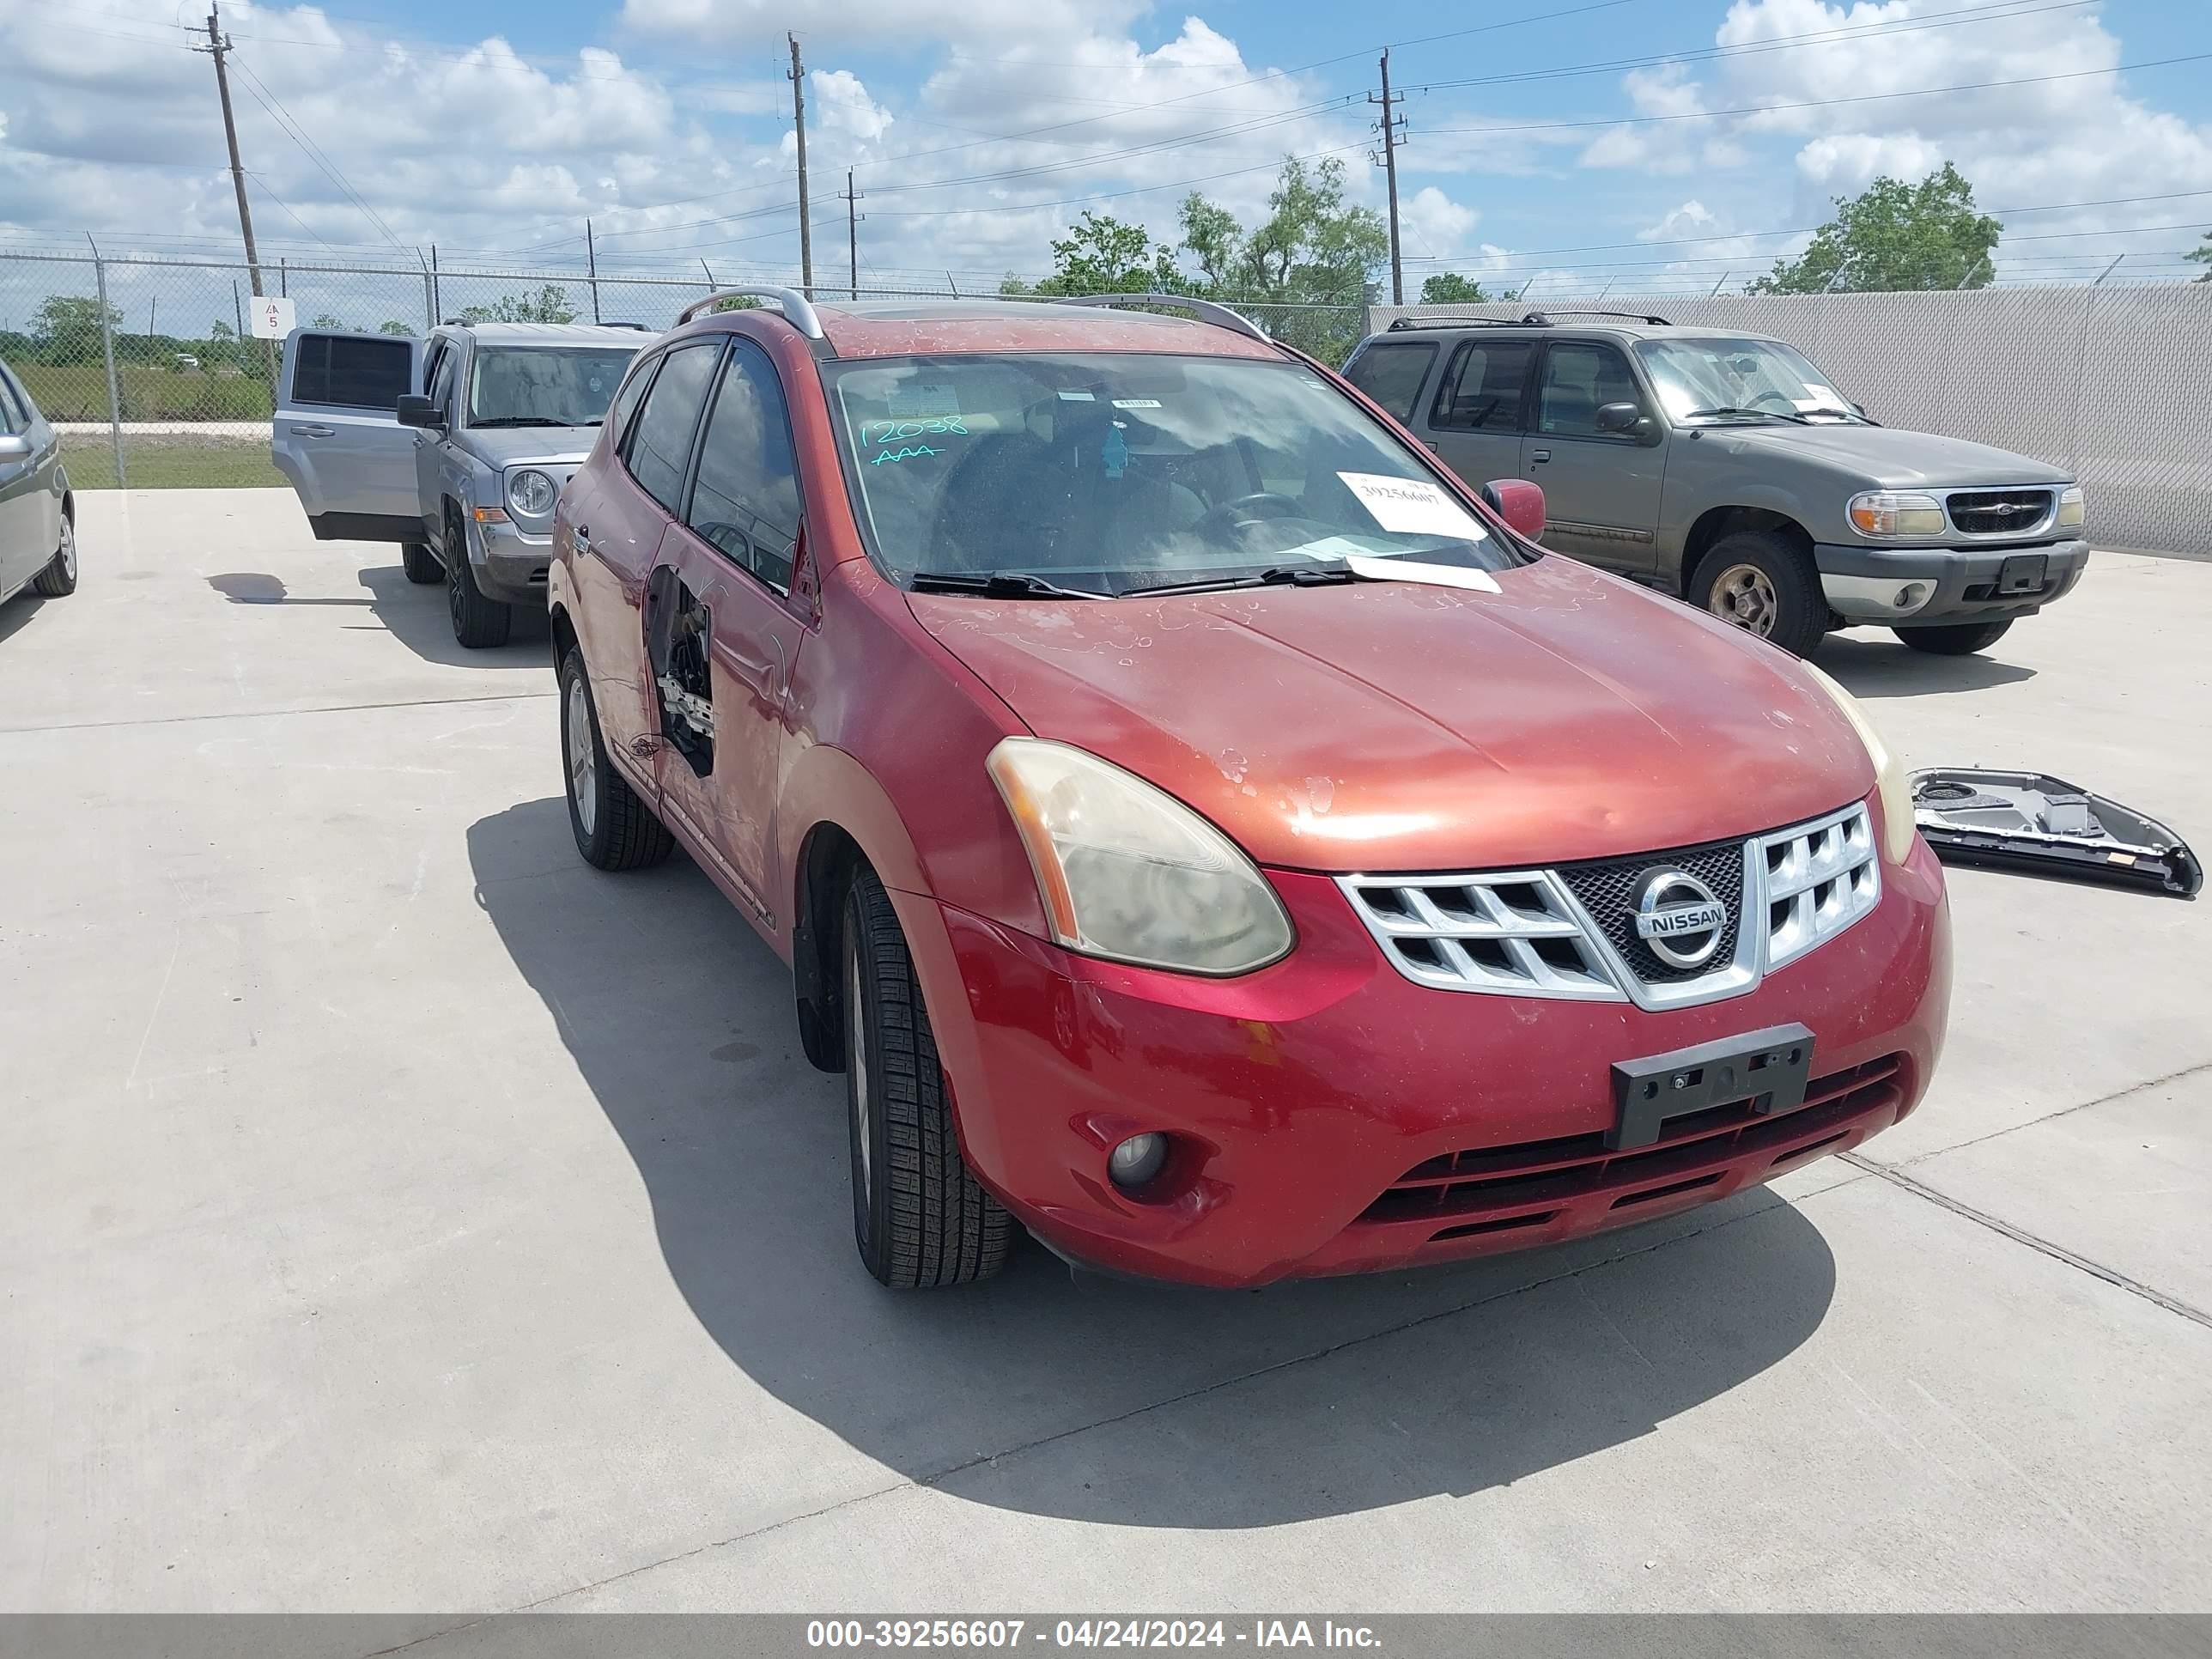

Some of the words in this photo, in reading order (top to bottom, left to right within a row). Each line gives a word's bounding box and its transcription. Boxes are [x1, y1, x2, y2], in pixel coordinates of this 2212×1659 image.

[270, 317, 277, 327] 5
[861, 416, 969, 447] 12038
[1651, 908, 1723, 933] NISSAN
